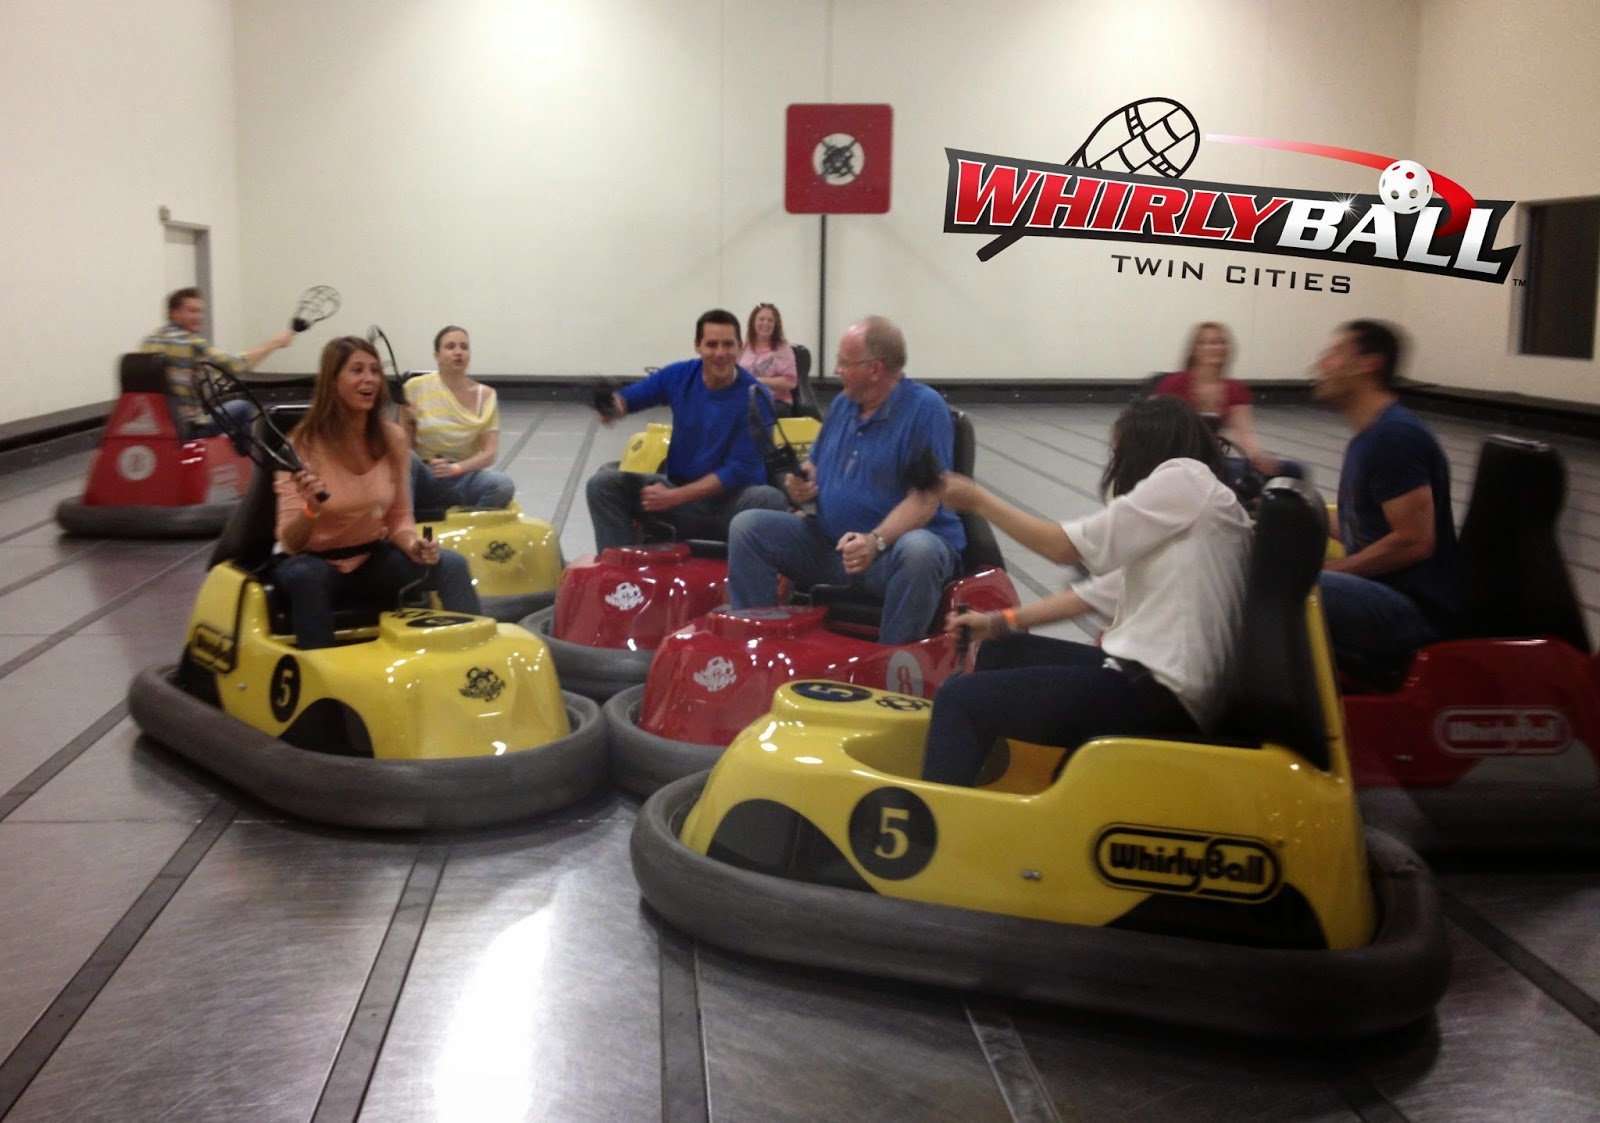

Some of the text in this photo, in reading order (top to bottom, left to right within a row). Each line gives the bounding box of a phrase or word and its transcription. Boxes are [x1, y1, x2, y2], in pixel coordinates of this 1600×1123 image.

[276, 669, 293, 707] 5
[808, 684, 854, 698] 5
[874, 806, 911, 859] 5
[1109, 841, 1266, 888] WhirlyBall
